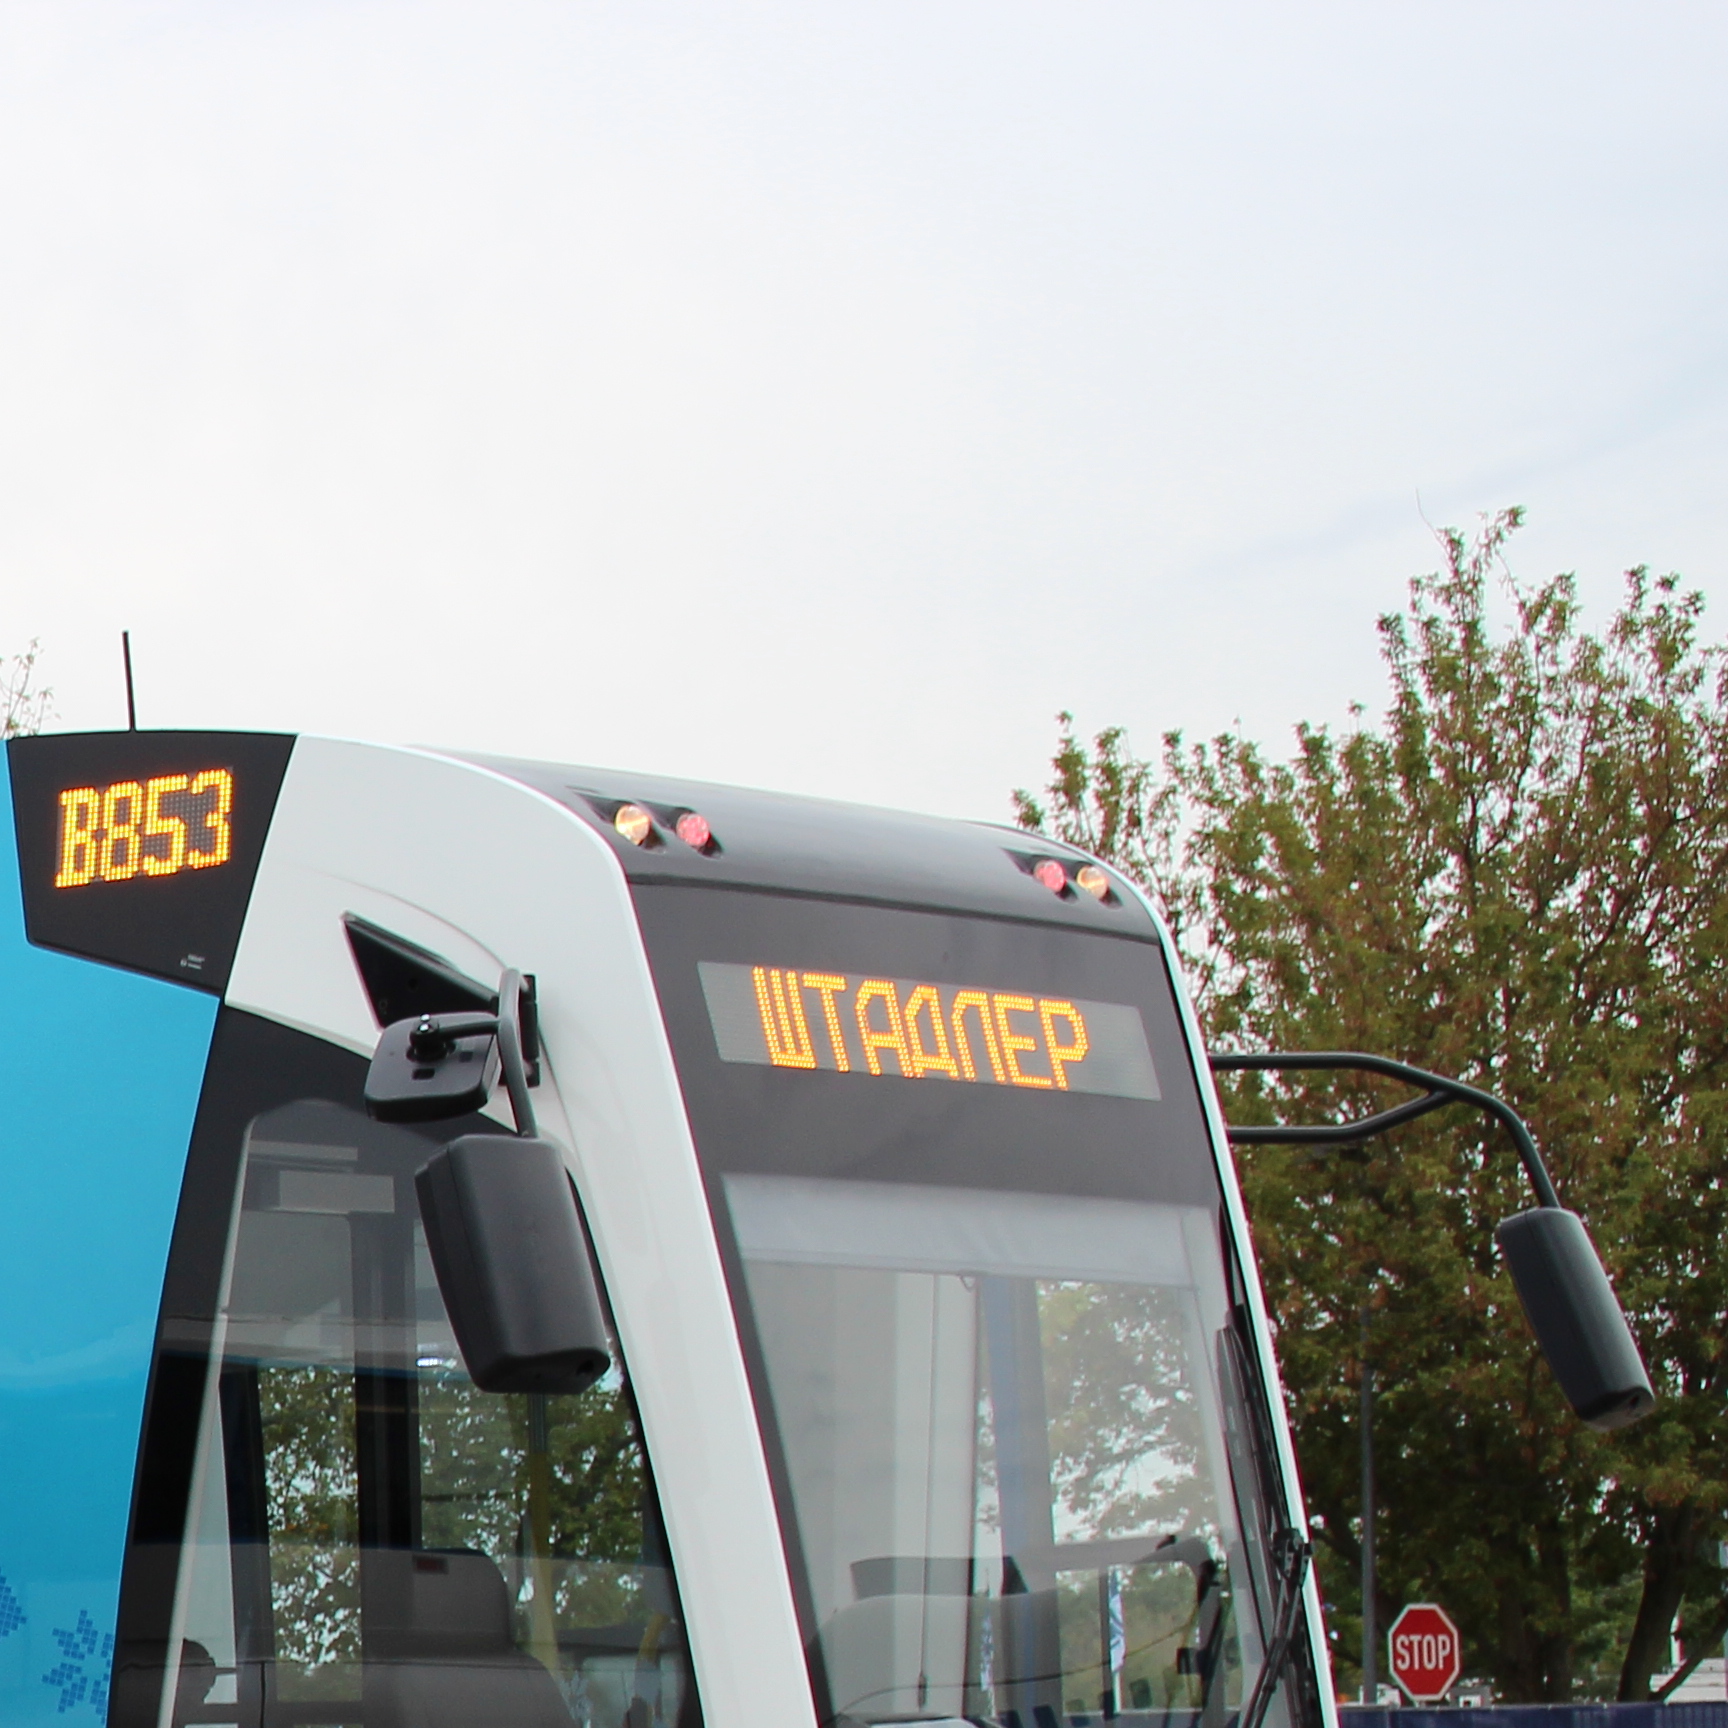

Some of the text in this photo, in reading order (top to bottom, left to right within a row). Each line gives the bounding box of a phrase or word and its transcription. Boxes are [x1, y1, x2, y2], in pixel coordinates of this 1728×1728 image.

[55, 768, 233, 888] B853
[751, 966, 1090, 1091] ШТАДЛЕР
[1395, 1634, 1451, 1671] STOP
